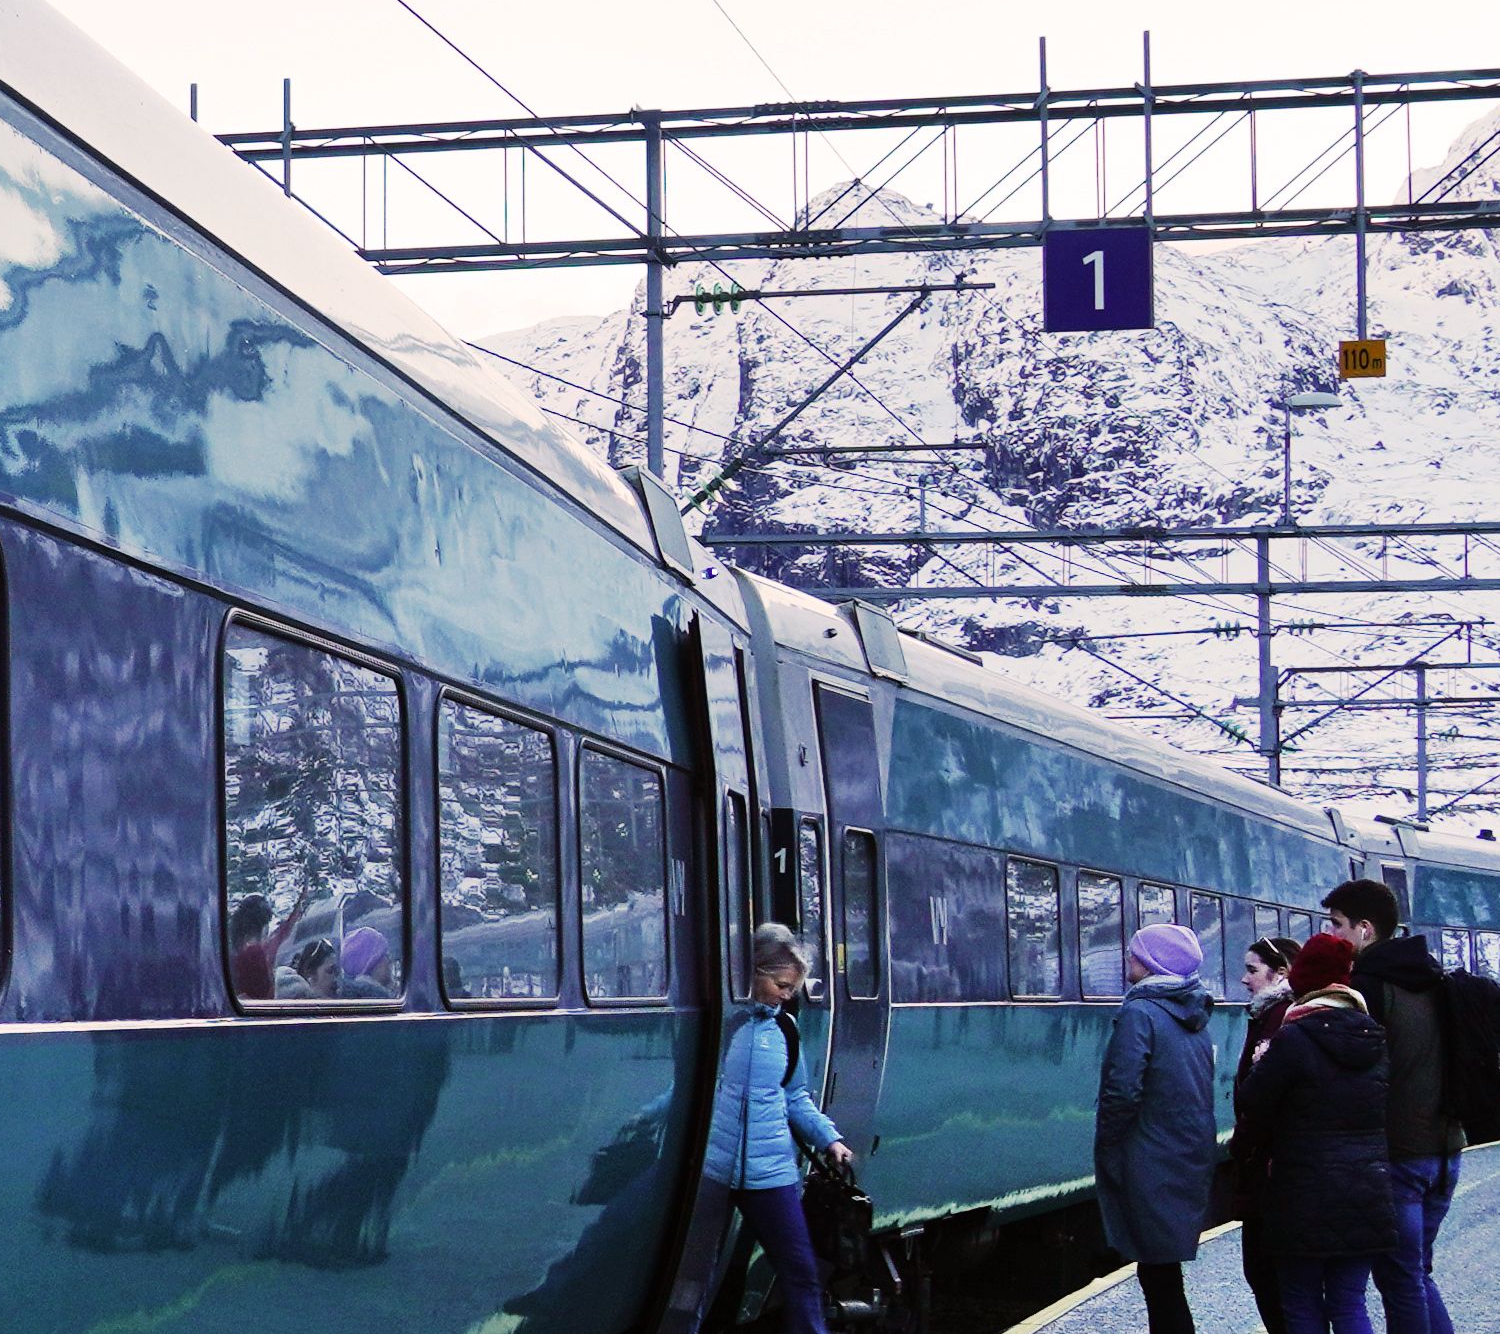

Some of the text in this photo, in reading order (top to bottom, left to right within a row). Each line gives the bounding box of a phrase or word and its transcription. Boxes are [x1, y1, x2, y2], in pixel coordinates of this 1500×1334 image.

[1081, 250, 1106, 310] 1
[1343, 348, 1382, 370] 110 m
[774, 847, 787, 874] 1
